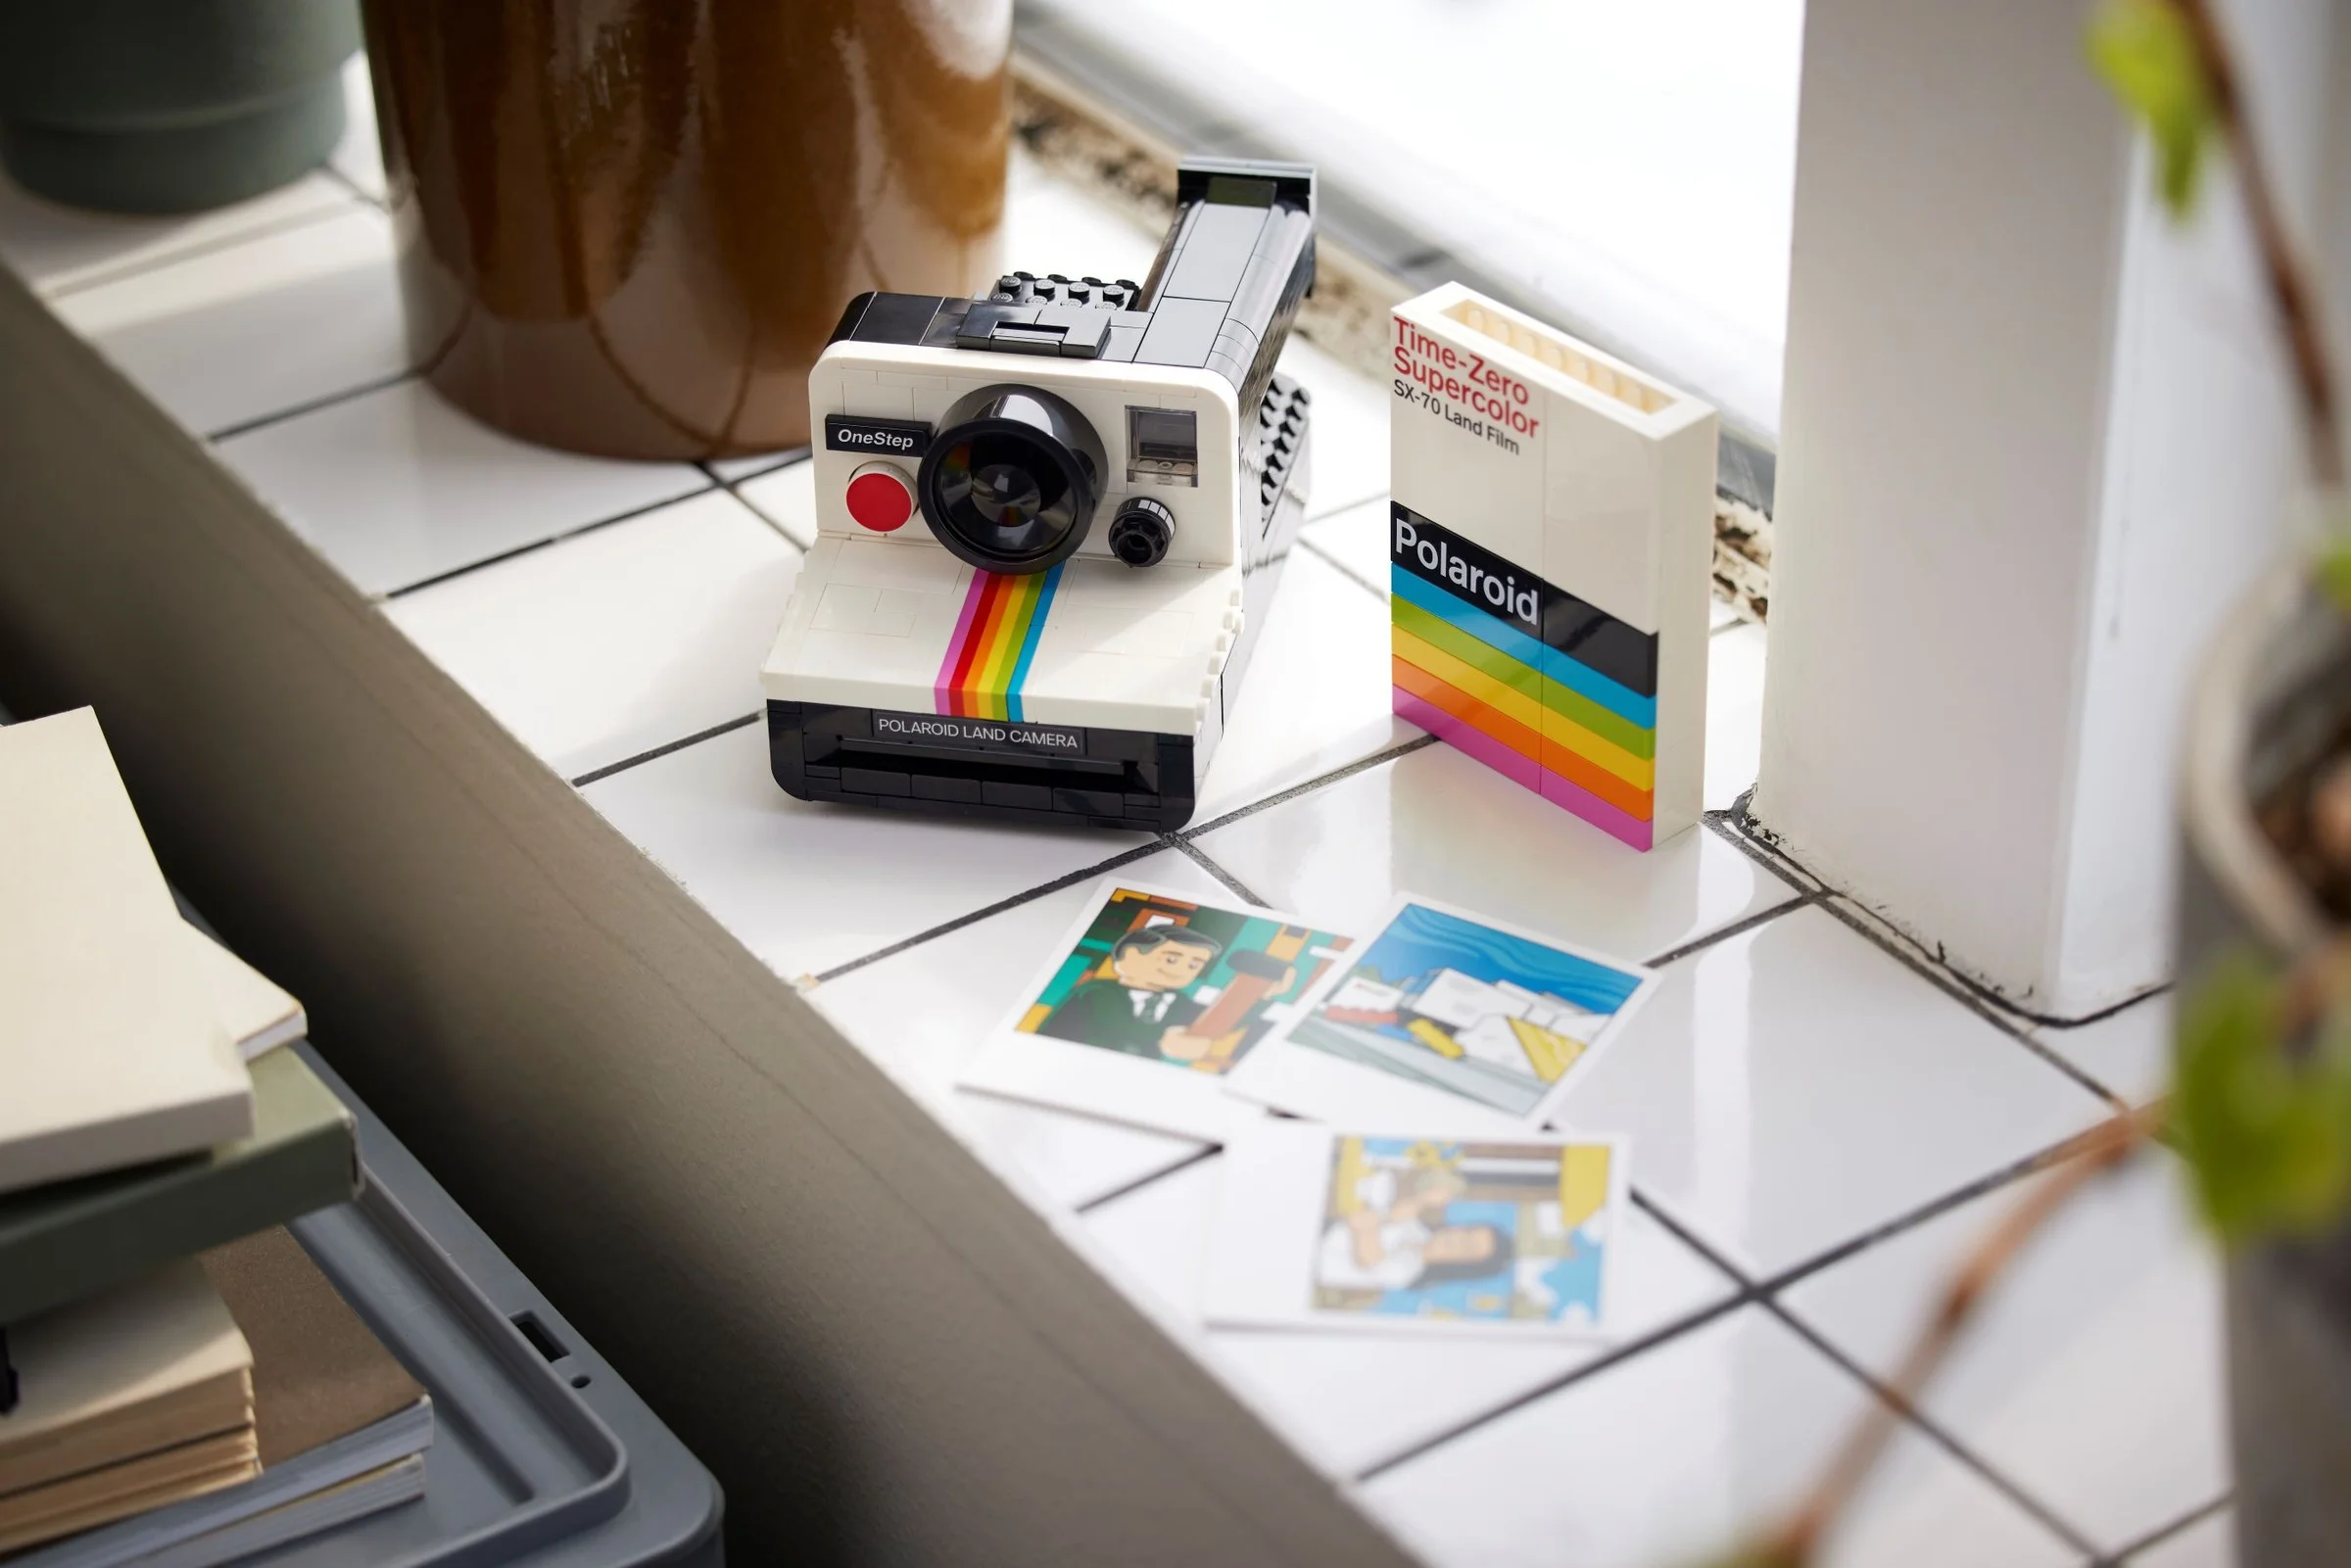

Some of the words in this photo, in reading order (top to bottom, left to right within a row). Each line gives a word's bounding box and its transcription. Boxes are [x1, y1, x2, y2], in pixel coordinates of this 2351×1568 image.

[1393, 315, 1529, 405] Time-Zero
[1393, 346, 1539, 438] Supercolor
[838, 429, 913, 451] OneStep
[1394, 379, 1441, 415] SX-70
[1445, 404, 1483, 437] Land
[1487, 425, 1519, 455] Film
[1395, 518, 1539, 626] Polaroid
[879, 719, 959, 736] POLAROID
[963, 726, 1006, 741] LAND
[1010, 730, 1078, 748] CAMERA
